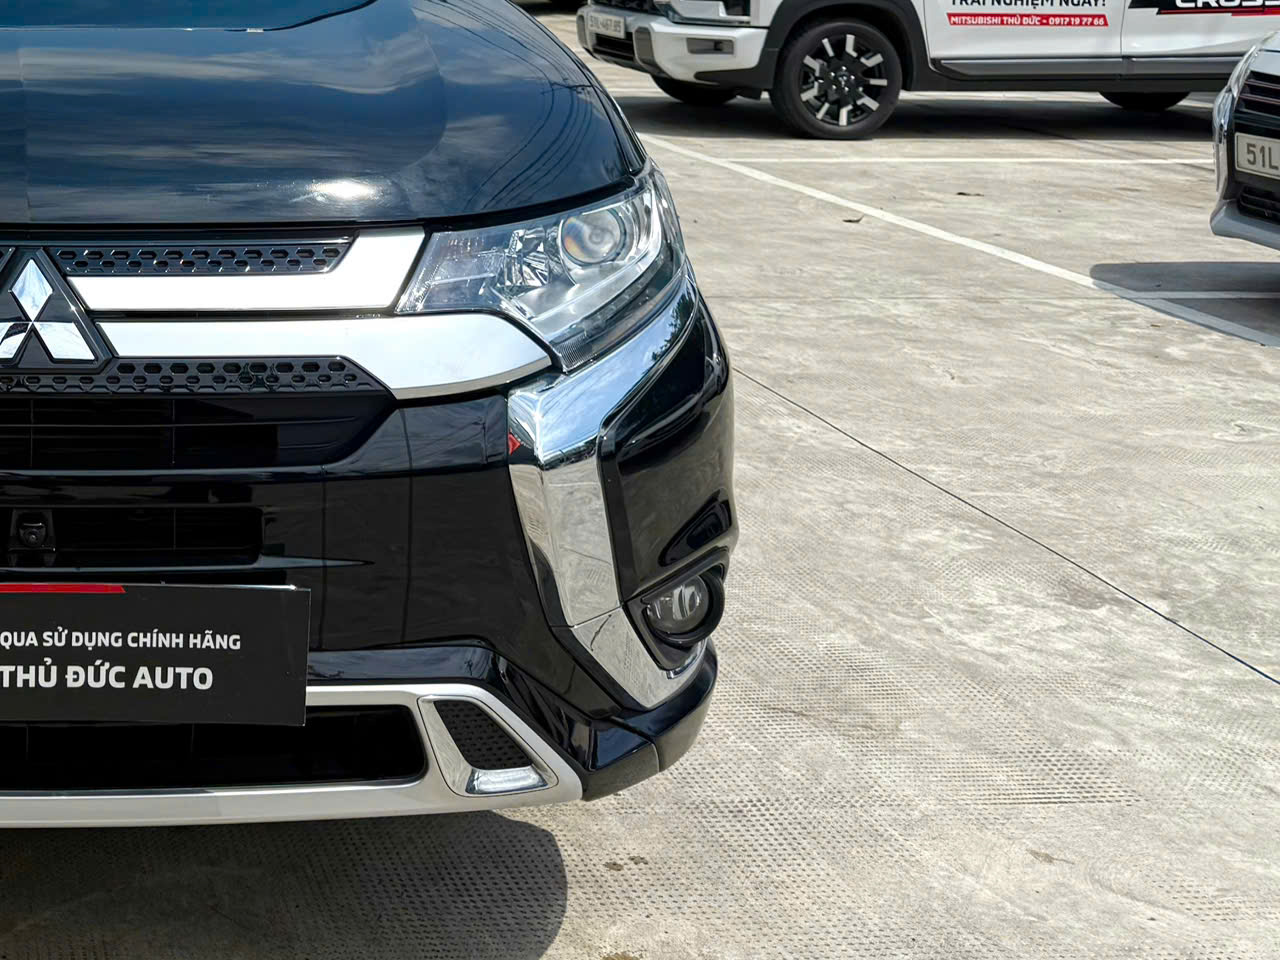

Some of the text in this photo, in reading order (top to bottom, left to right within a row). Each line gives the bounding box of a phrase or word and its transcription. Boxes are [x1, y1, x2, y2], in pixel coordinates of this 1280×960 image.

[950, 16, 1001, 25] MITSUBISHI
[1003, 14, 1020, 25] THỦ
[1022, 14, 1040, 25] ĐỨC
[1049, 16, 1069, 25] 0917
[1071, 16, 1080, 25] 19
[1081, 17, 1092, 25] 77
[1093, 17, 1105, 25] 66
[0, 631, 38, 650] QUA
[42, 626, 68, 647] SỬ
[71, 631, 122, 650] DỤNG
[127, 628, 183, 648] CHÍNH
[189, 630, 241, 650] HÃNG
[65, 659, 126, 688] ĐỨC
[132, 666, 213, 690] AUTO
